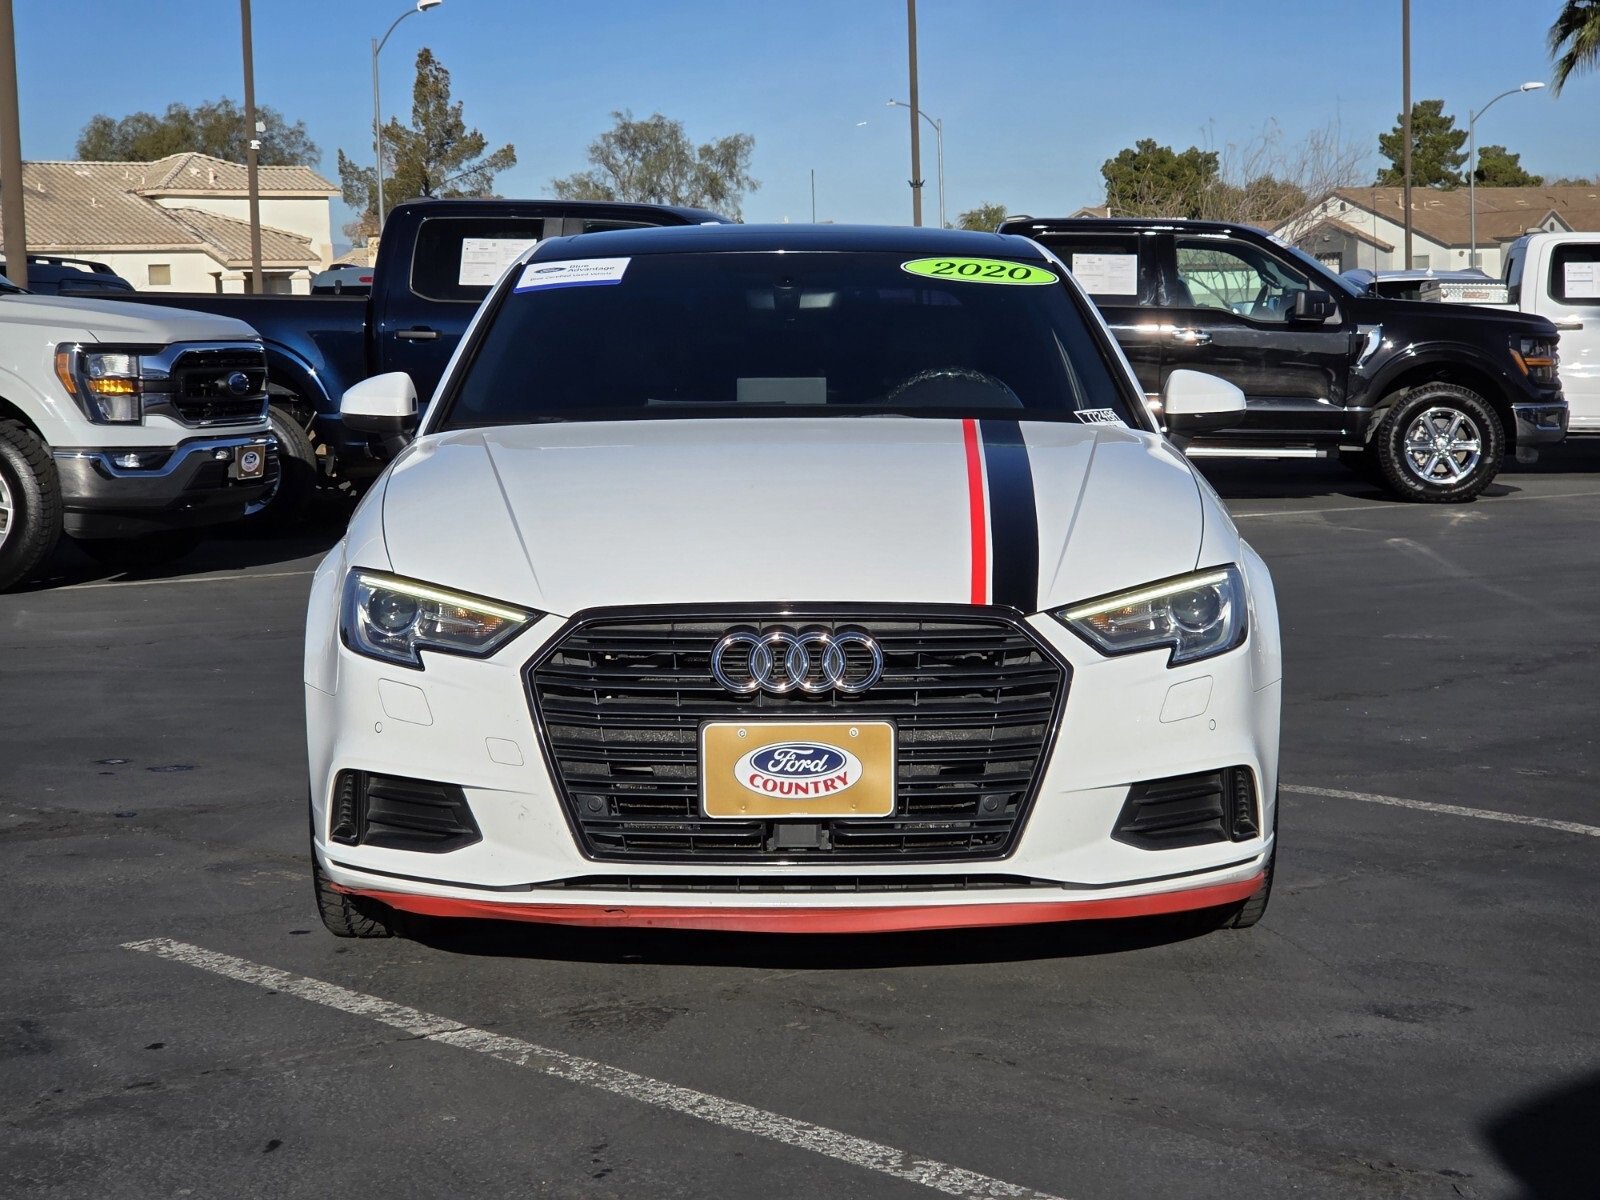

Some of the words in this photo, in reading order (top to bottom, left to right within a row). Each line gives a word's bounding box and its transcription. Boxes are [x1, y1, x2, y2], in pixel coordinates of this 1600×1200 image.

[931, 261, 1032, 280] 2020
[767, 748, 829, 773] Ford
[749, 771, 849, 796] COUNTRY
